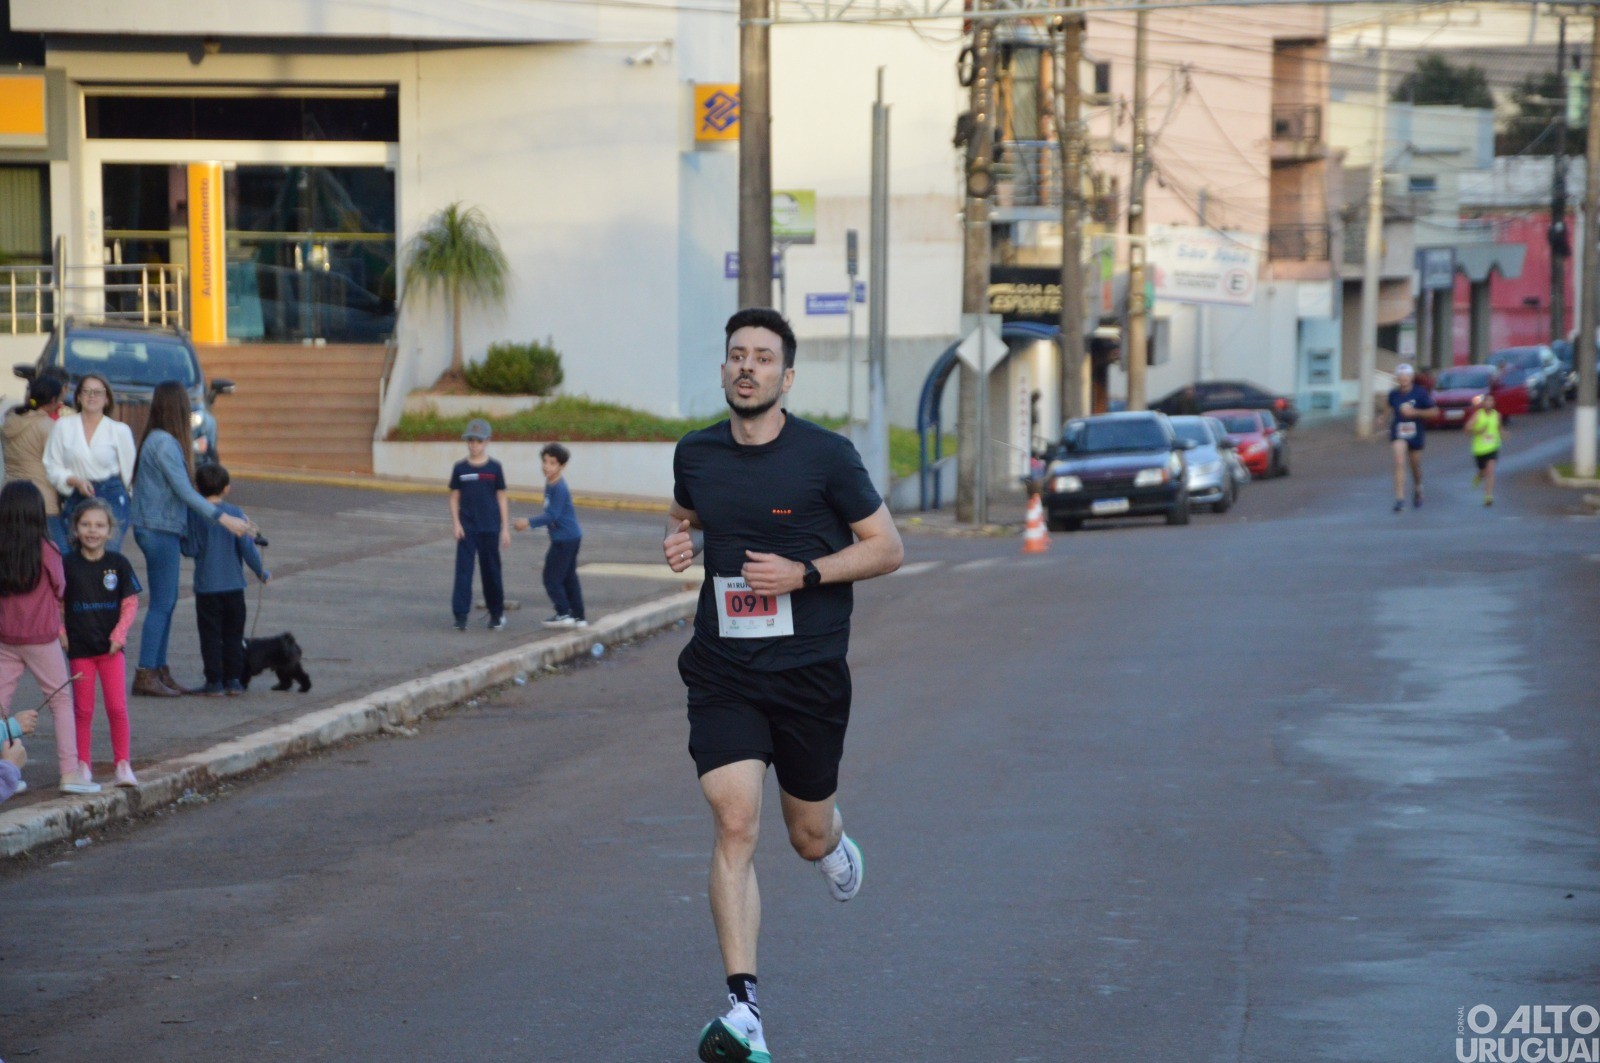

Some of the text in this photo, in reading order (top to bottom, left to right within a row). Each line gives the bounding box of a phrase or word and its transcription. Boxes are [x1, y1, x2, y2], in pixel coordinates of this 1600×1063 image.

[201, 178, 211, 297] Autoatendimento
[1231, 274, 1245, 290] E
[991, 295, 1063, 311] ESPORTE
[731, 595, 769, 613] 091
